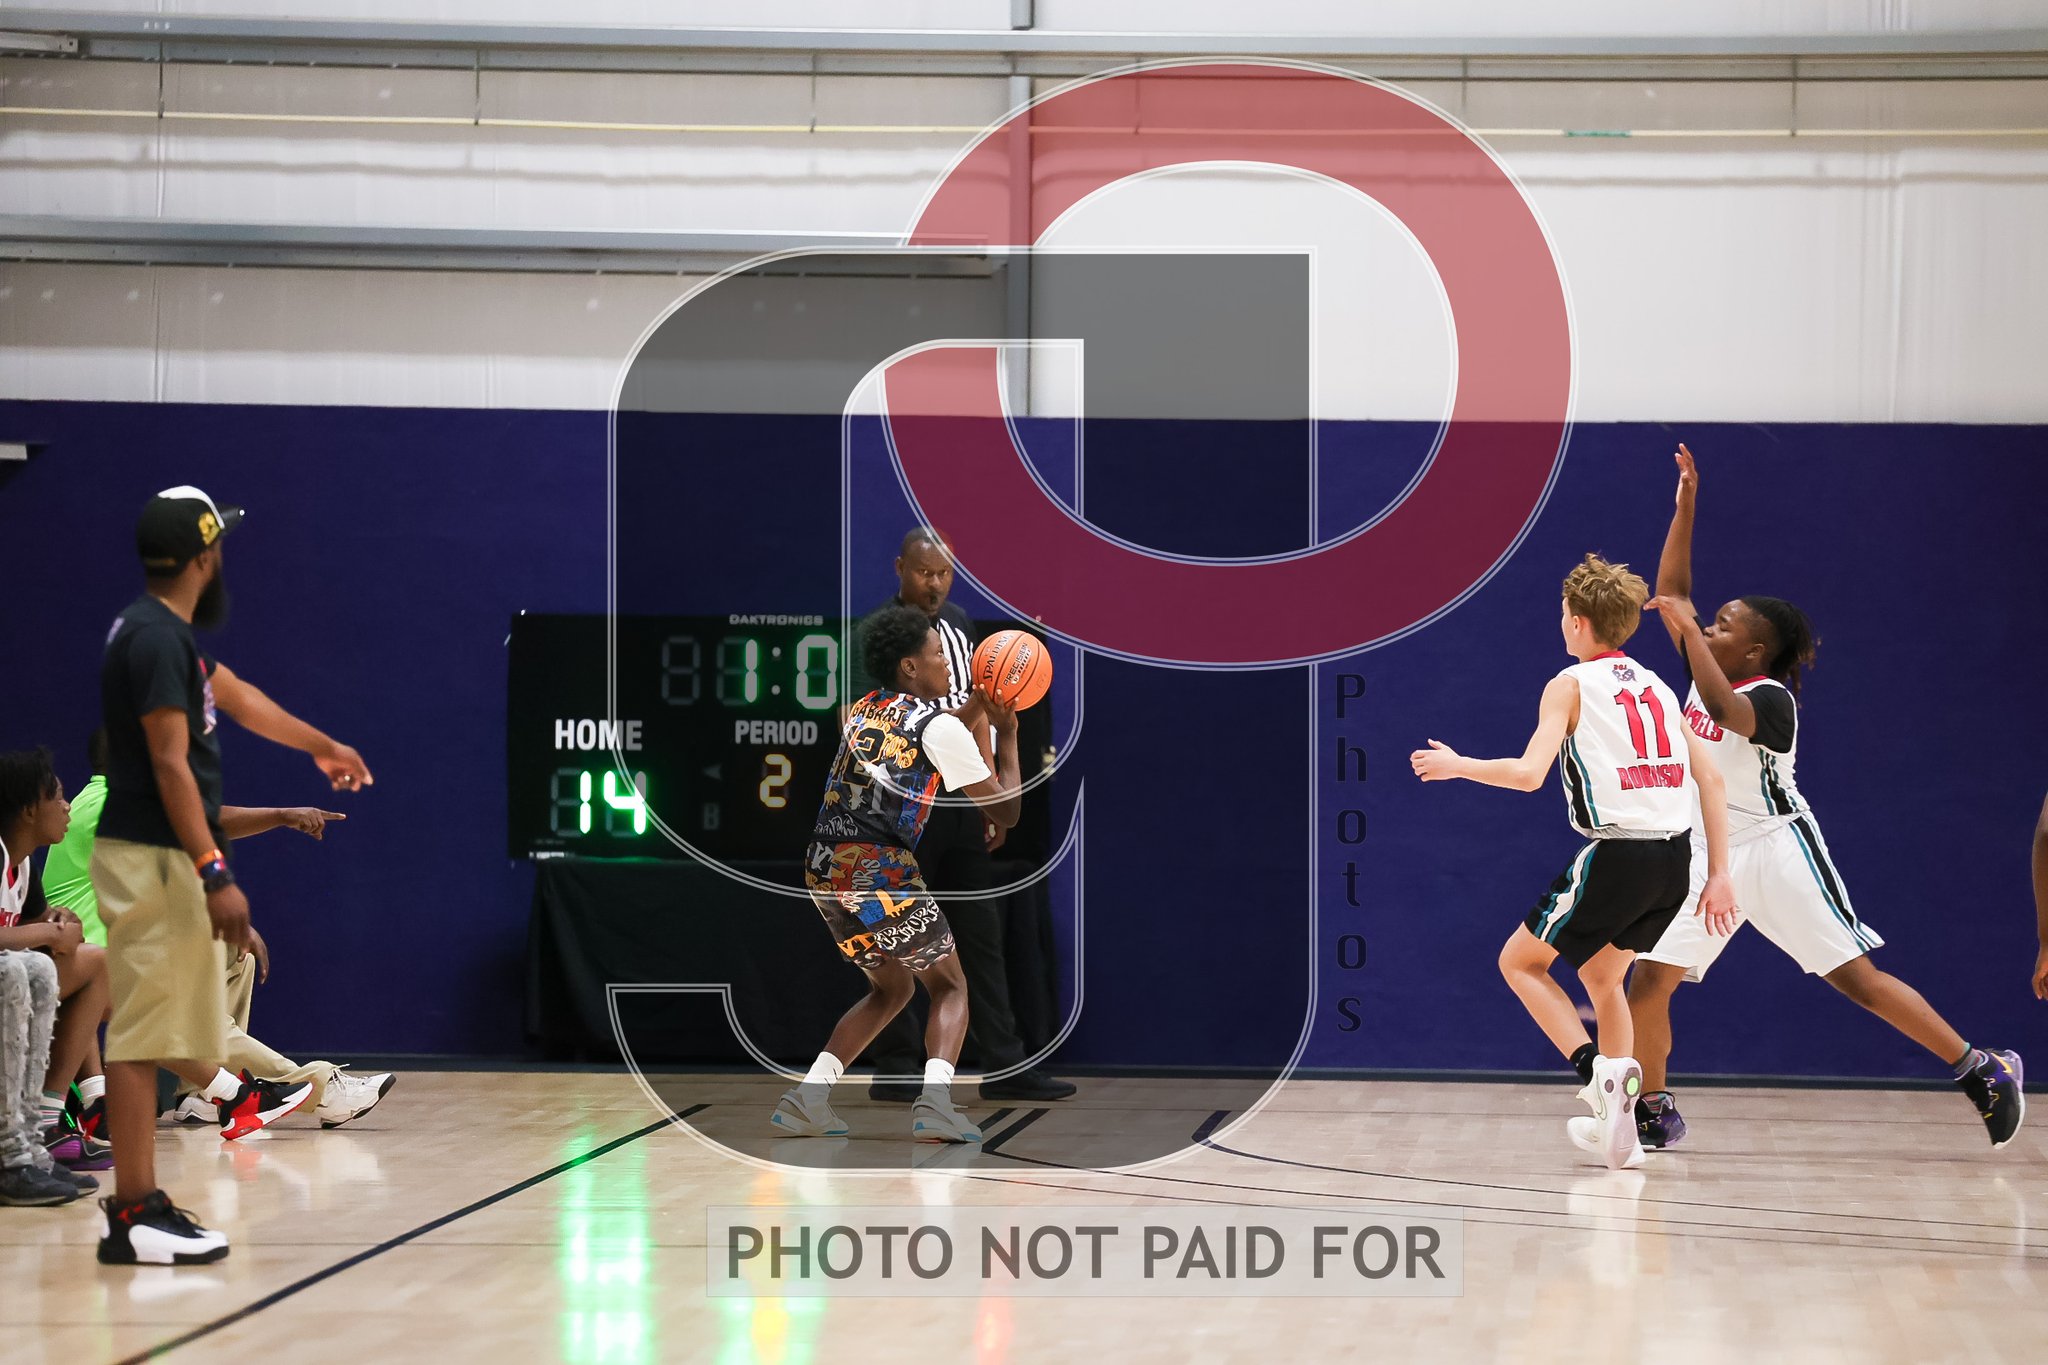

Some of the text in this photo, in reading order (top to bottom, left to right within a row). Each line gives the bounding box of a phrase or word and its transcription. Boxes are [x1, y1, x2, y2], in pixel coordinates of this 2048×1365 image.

[729, 614, 824, 626] DAKTRONICS
[1004, 642, 1028, 686] PRECISION
[555, 719, 643, 751] HOME
[735, 720, 818, 745] PERIOD
[1614, 685, 1672, 759] 11
[579, 770, 646, 834] 14
[759, 754, 792, 808] 2
